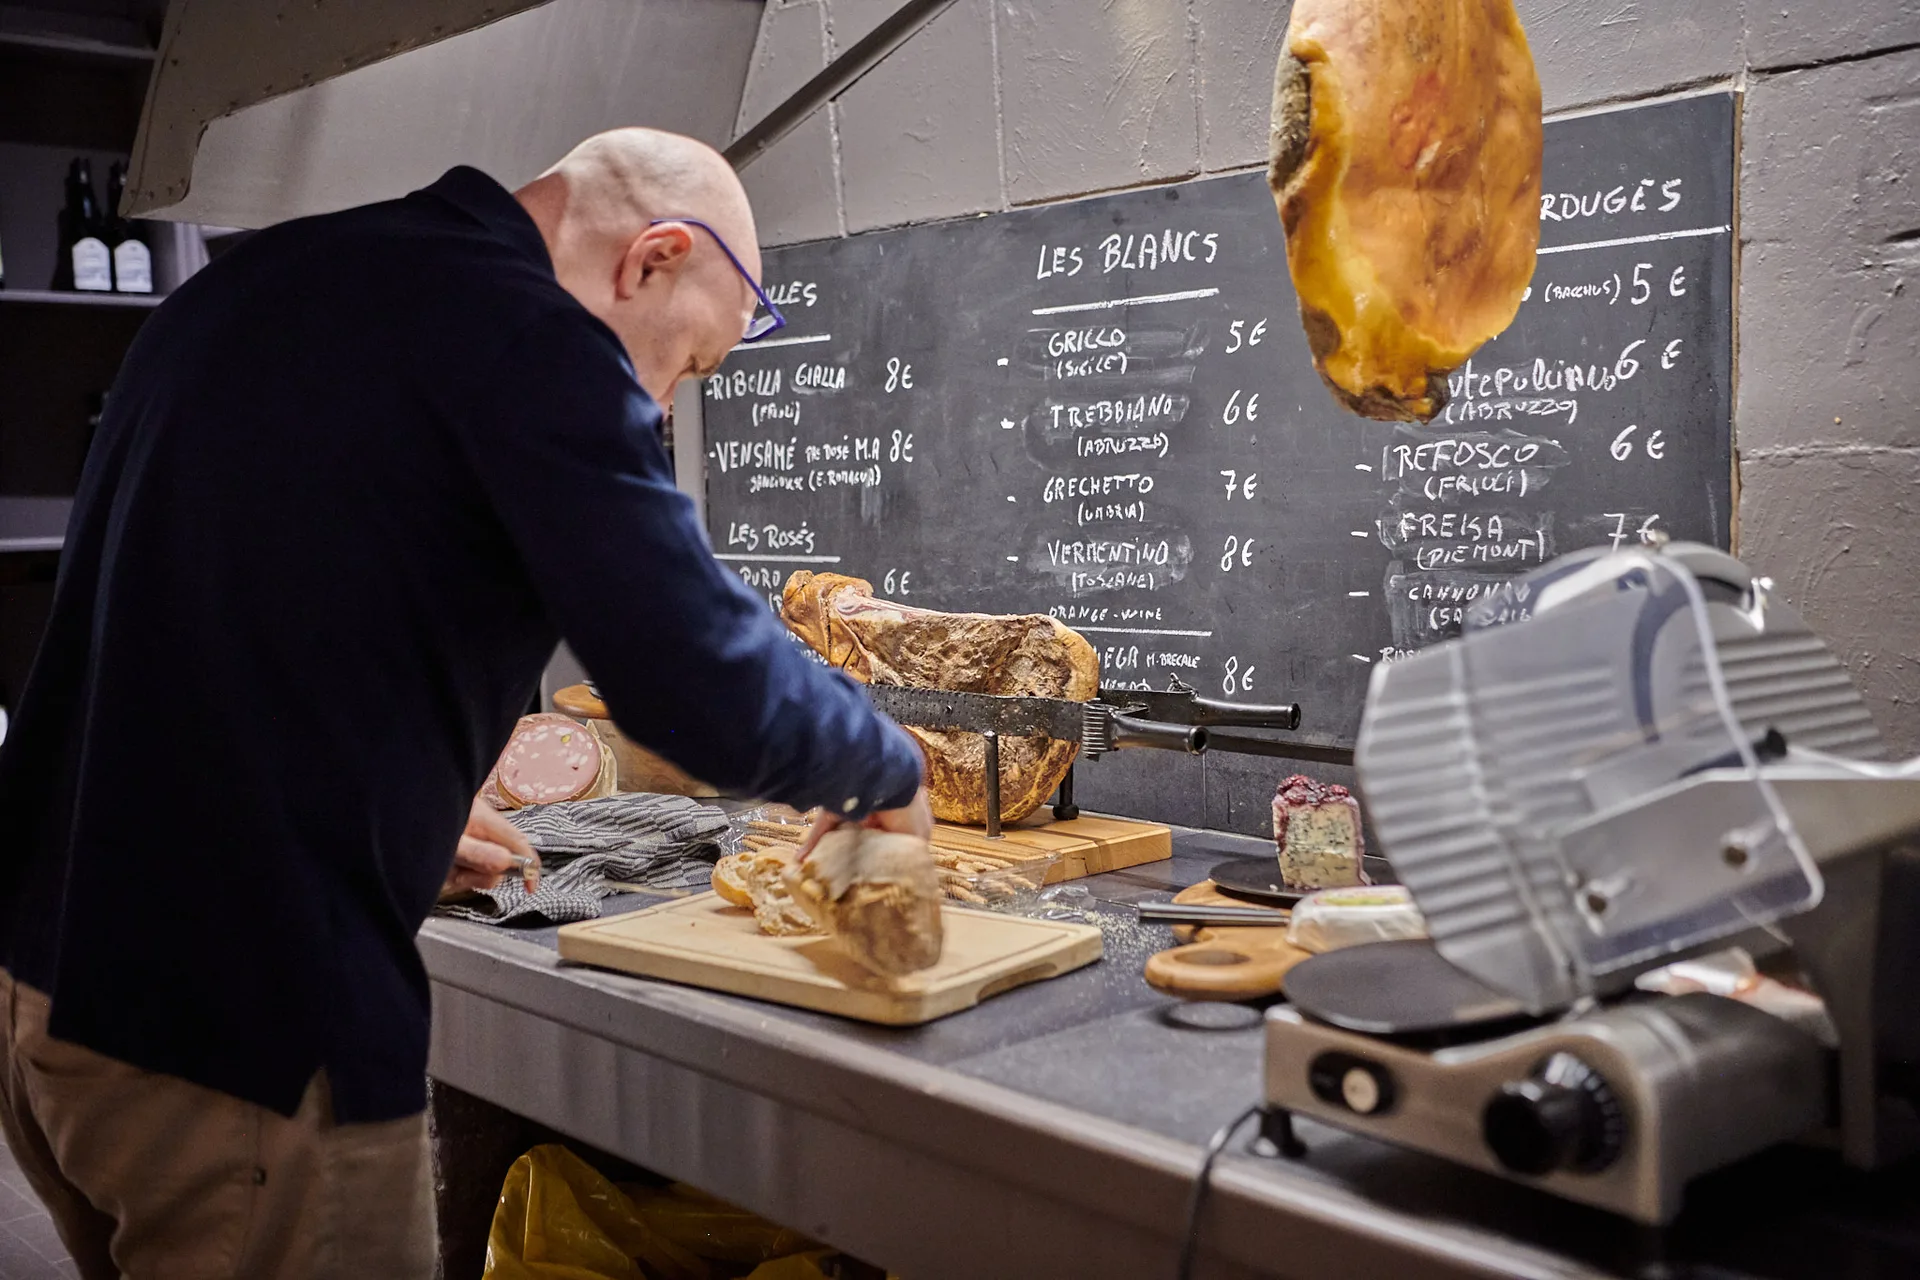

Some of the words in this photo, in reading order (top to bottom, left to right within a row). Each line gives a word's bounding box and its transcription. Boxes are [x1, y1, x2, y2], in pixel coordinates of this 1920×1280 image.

[1036, 244, 1083, 280] LES
[1098, 229, 1219, 274] BLANCS
[759, 281, 817, 306] ULLES
[1630, 263, 1653, 306] 5
[795, 363, 846, 389] GIALLA
[1077, 431, 1169, 458] (ABRUZZO)
[1610, 424, 1637, 461] 6
[1393, 440, 1540, 477] REFOSCO
[1043, 473, 1154, 503] GRECHETTO
[728, 522, 759, 552] LES
[1400, 512, 1504, 543] FREISA
